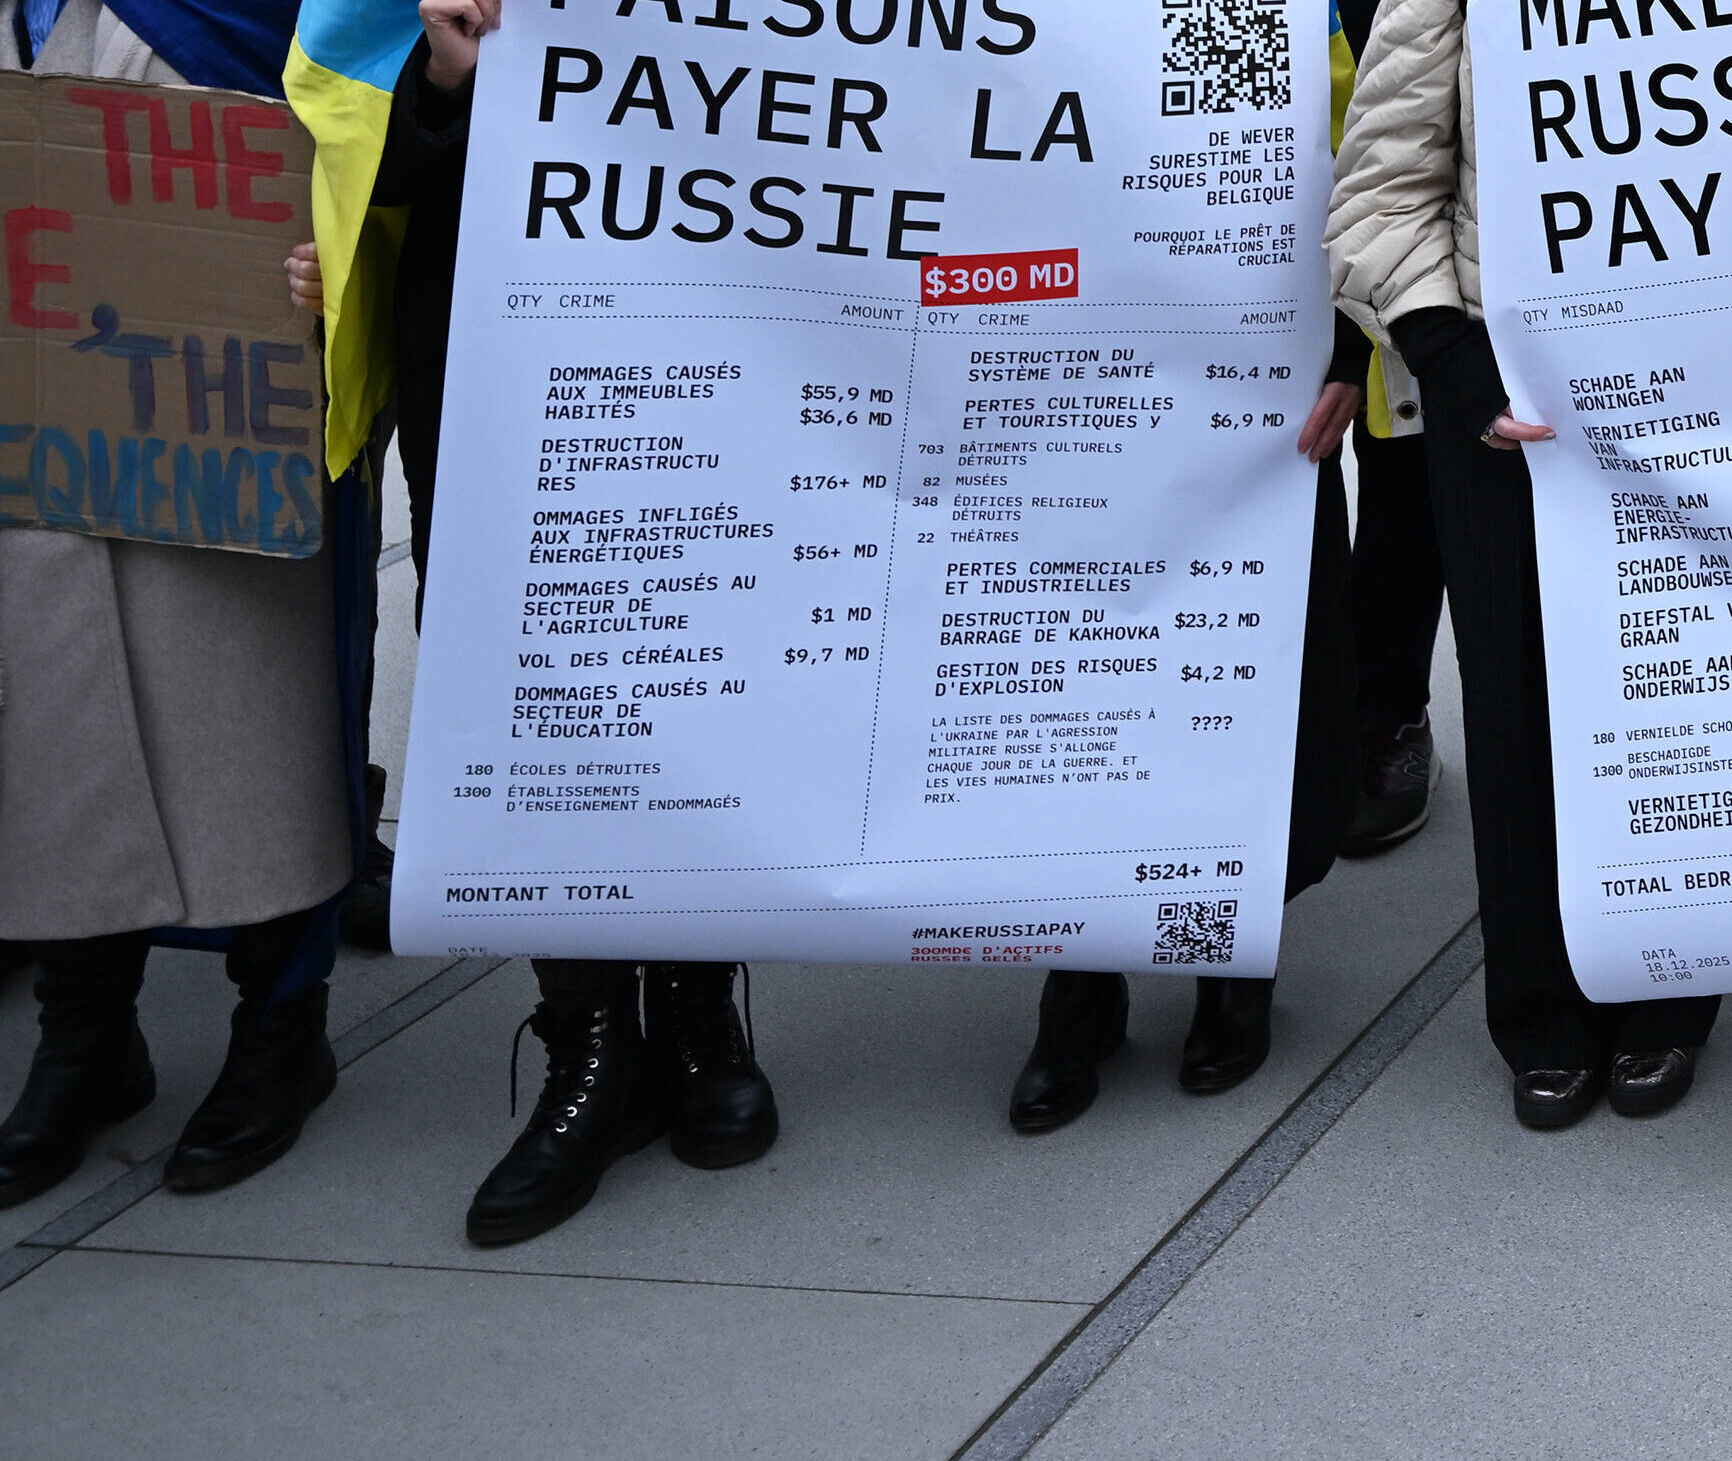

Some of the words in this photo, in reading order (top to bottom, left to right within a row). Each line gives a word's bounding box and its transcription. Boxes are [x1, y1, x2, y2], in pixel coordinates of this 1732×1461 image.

[538, 46, 888, 152] PAYER
[970, 88, 1094, 163] LA
[1209, 132, 1230, 147] DE
[1241, 127, 1294, 145] WEVER
[68, 87, 293, 222] THE
[1149, 150, 1252, 170] SURESTIME
[1264, 147, 1294, 163] LES
[1122, 172, 1207, 191] RISQUES
[1219, 168, 1262, 184] POUR
[1274, 166, 1295, 182] LA
[1207, 185, 1294, 206] BELGIQUE
[525, 161, 945, 261] RUSSIE
[1540, 171, 1722, 275] PAY
[924, 266, 1018, 298] $300
[1029, 262, 1075, 290] MD
[917, 443, 945, 455] 703
[959, 440, 1034, 454] BÂTIMENTS
[1038, 441, 1123, 455] CULTURELS
[1592, 732, 1616, 745] 180
[1625, 723, 1694, 742] VERNIELDE
[465, 764, 494, 776] 180
[509, 760, 567, 777] ÉCOLES
[576, 759, 662, 776] DÉTRUITES
[446, 885, 549, 903] MONTANT
[564, 884, 634, 901] TOTAL
[1134, 862, 1202, 884] $524+
[1216, 861, 1243, 877] MD
[1602, 877, 1672, 898] TOTAAL
[911, 921, 1085, 939] #MAKERUSSIAPAY
[1642, 949, 1676, 961] DATA
[1646, 957, 1730, 973] 18.12.2025
[1650, 972, 1693, 983] 10:00
